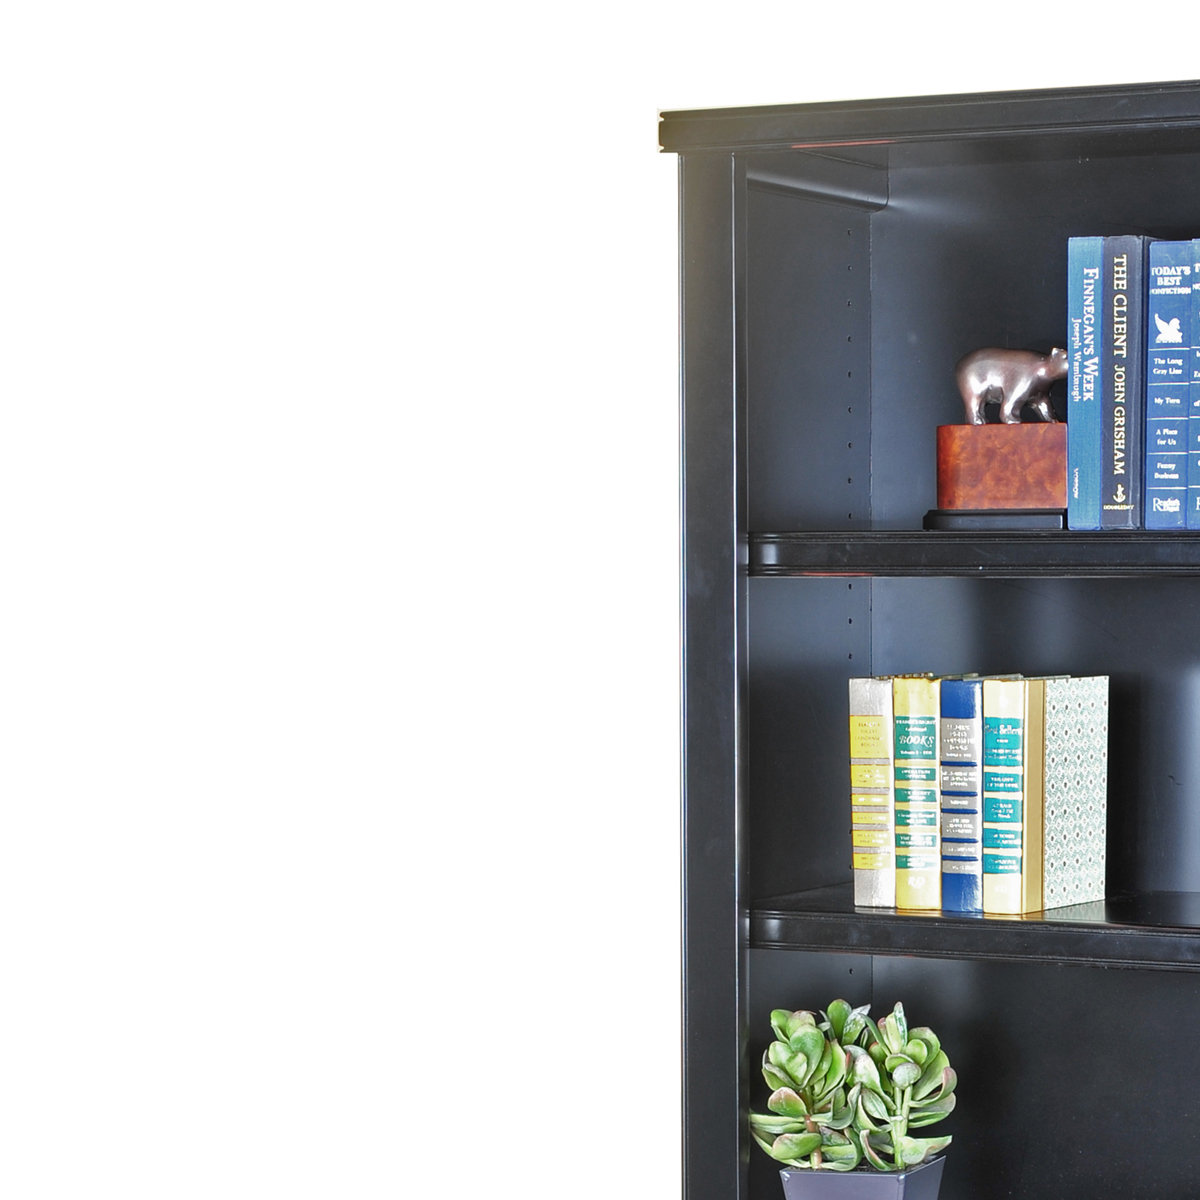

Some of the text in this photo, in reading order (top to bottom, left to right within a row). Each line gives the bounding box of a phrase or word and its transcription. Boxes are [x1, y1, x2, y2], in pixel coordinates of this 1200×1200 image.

[1157, 276, 1182, 286] BEST
[1083, 267, 1099, 402] FINNEGAN'S WEEK
[1071, 317, 1082, 402] Joseph Wambaugh
[1113, 254, 1128, 475] THE CLIENT JOHN GRISHAM
[1167, 358, 1183, 366] Long
[1154, 397, 1164, 405] My
[1167, 438, 1176, 446] Us
